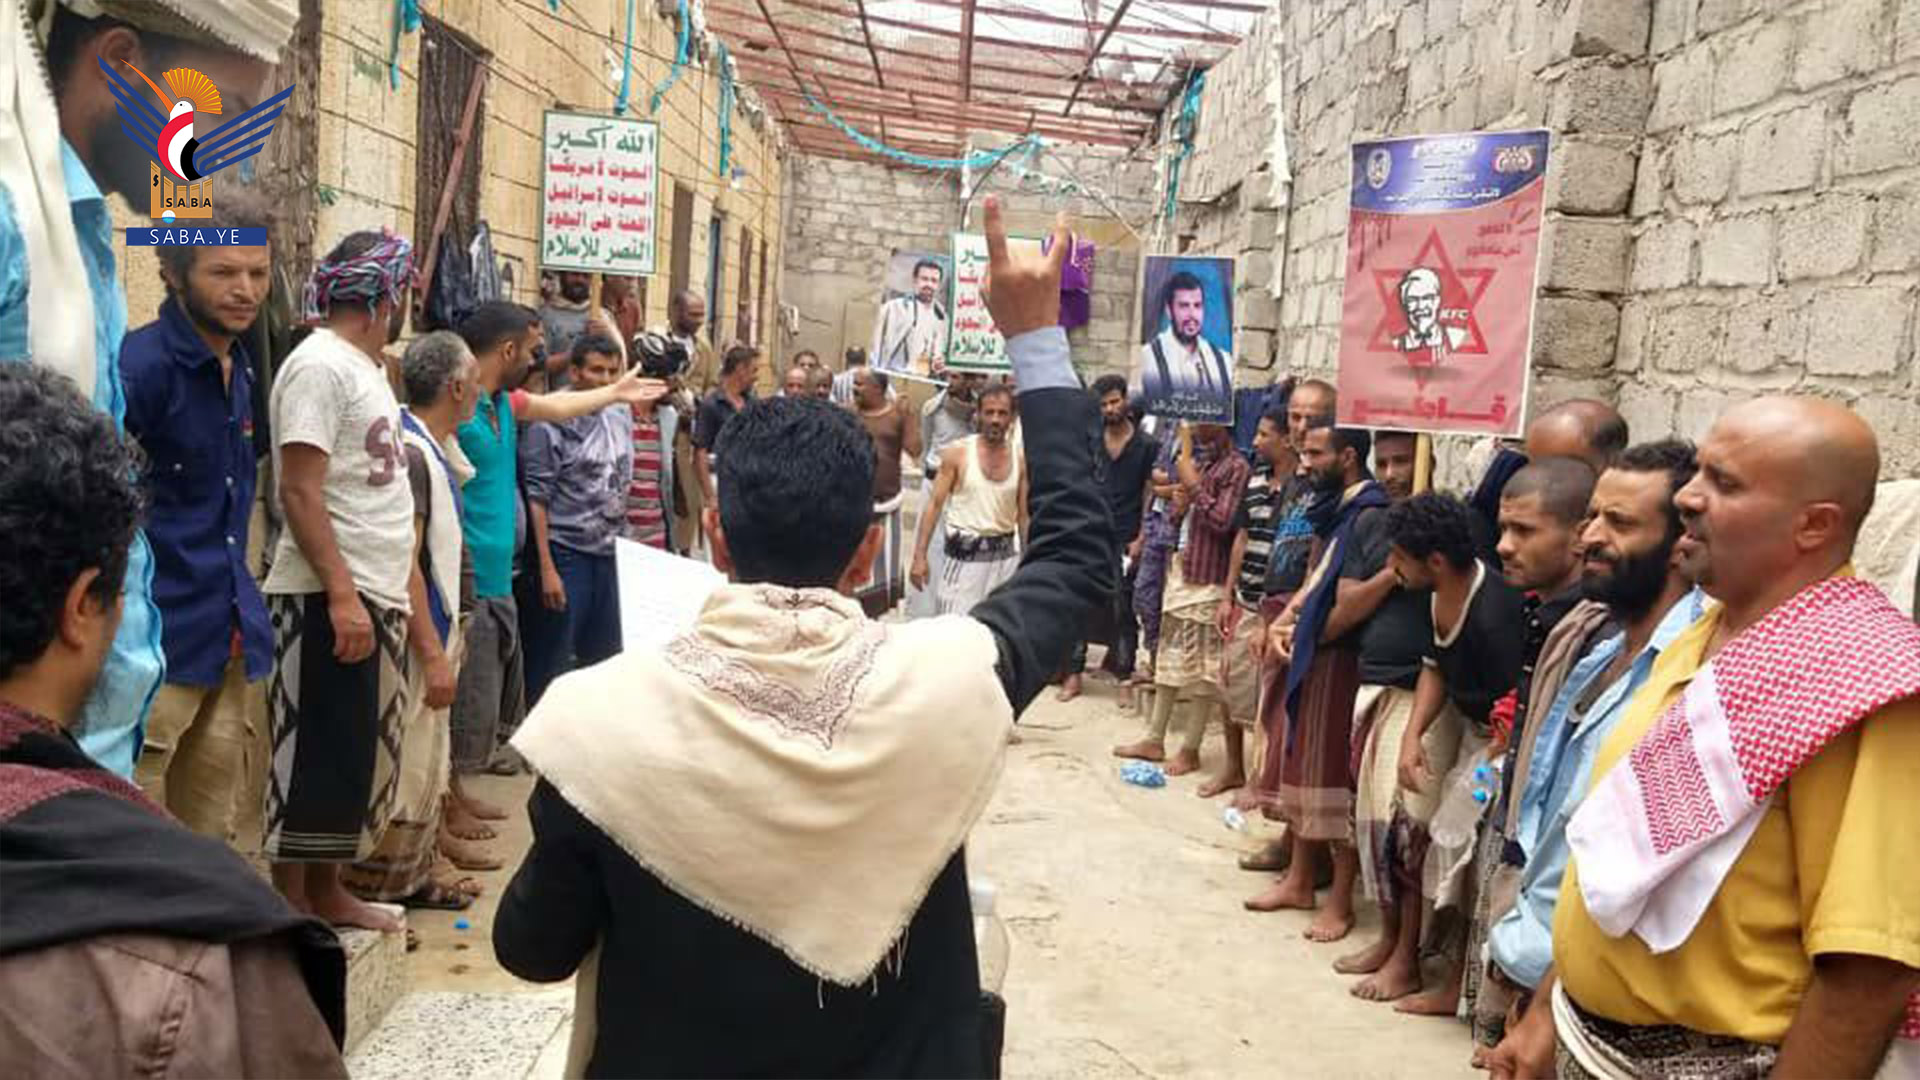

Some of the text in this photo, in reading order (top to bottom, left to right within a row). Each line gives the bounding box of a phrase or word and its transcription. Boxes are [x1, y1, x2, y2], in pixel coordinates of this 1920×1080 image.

[550, 121, 654, 153] الله أكبر
[608, 162, 652, 181] الموت
[608, 189, 652, 209] الموت
[546, 210, 651, 233] اللعنة على اليهود
[604, 238, 651, 264] النصر
[1439, 308, 1470, 320] KFC
